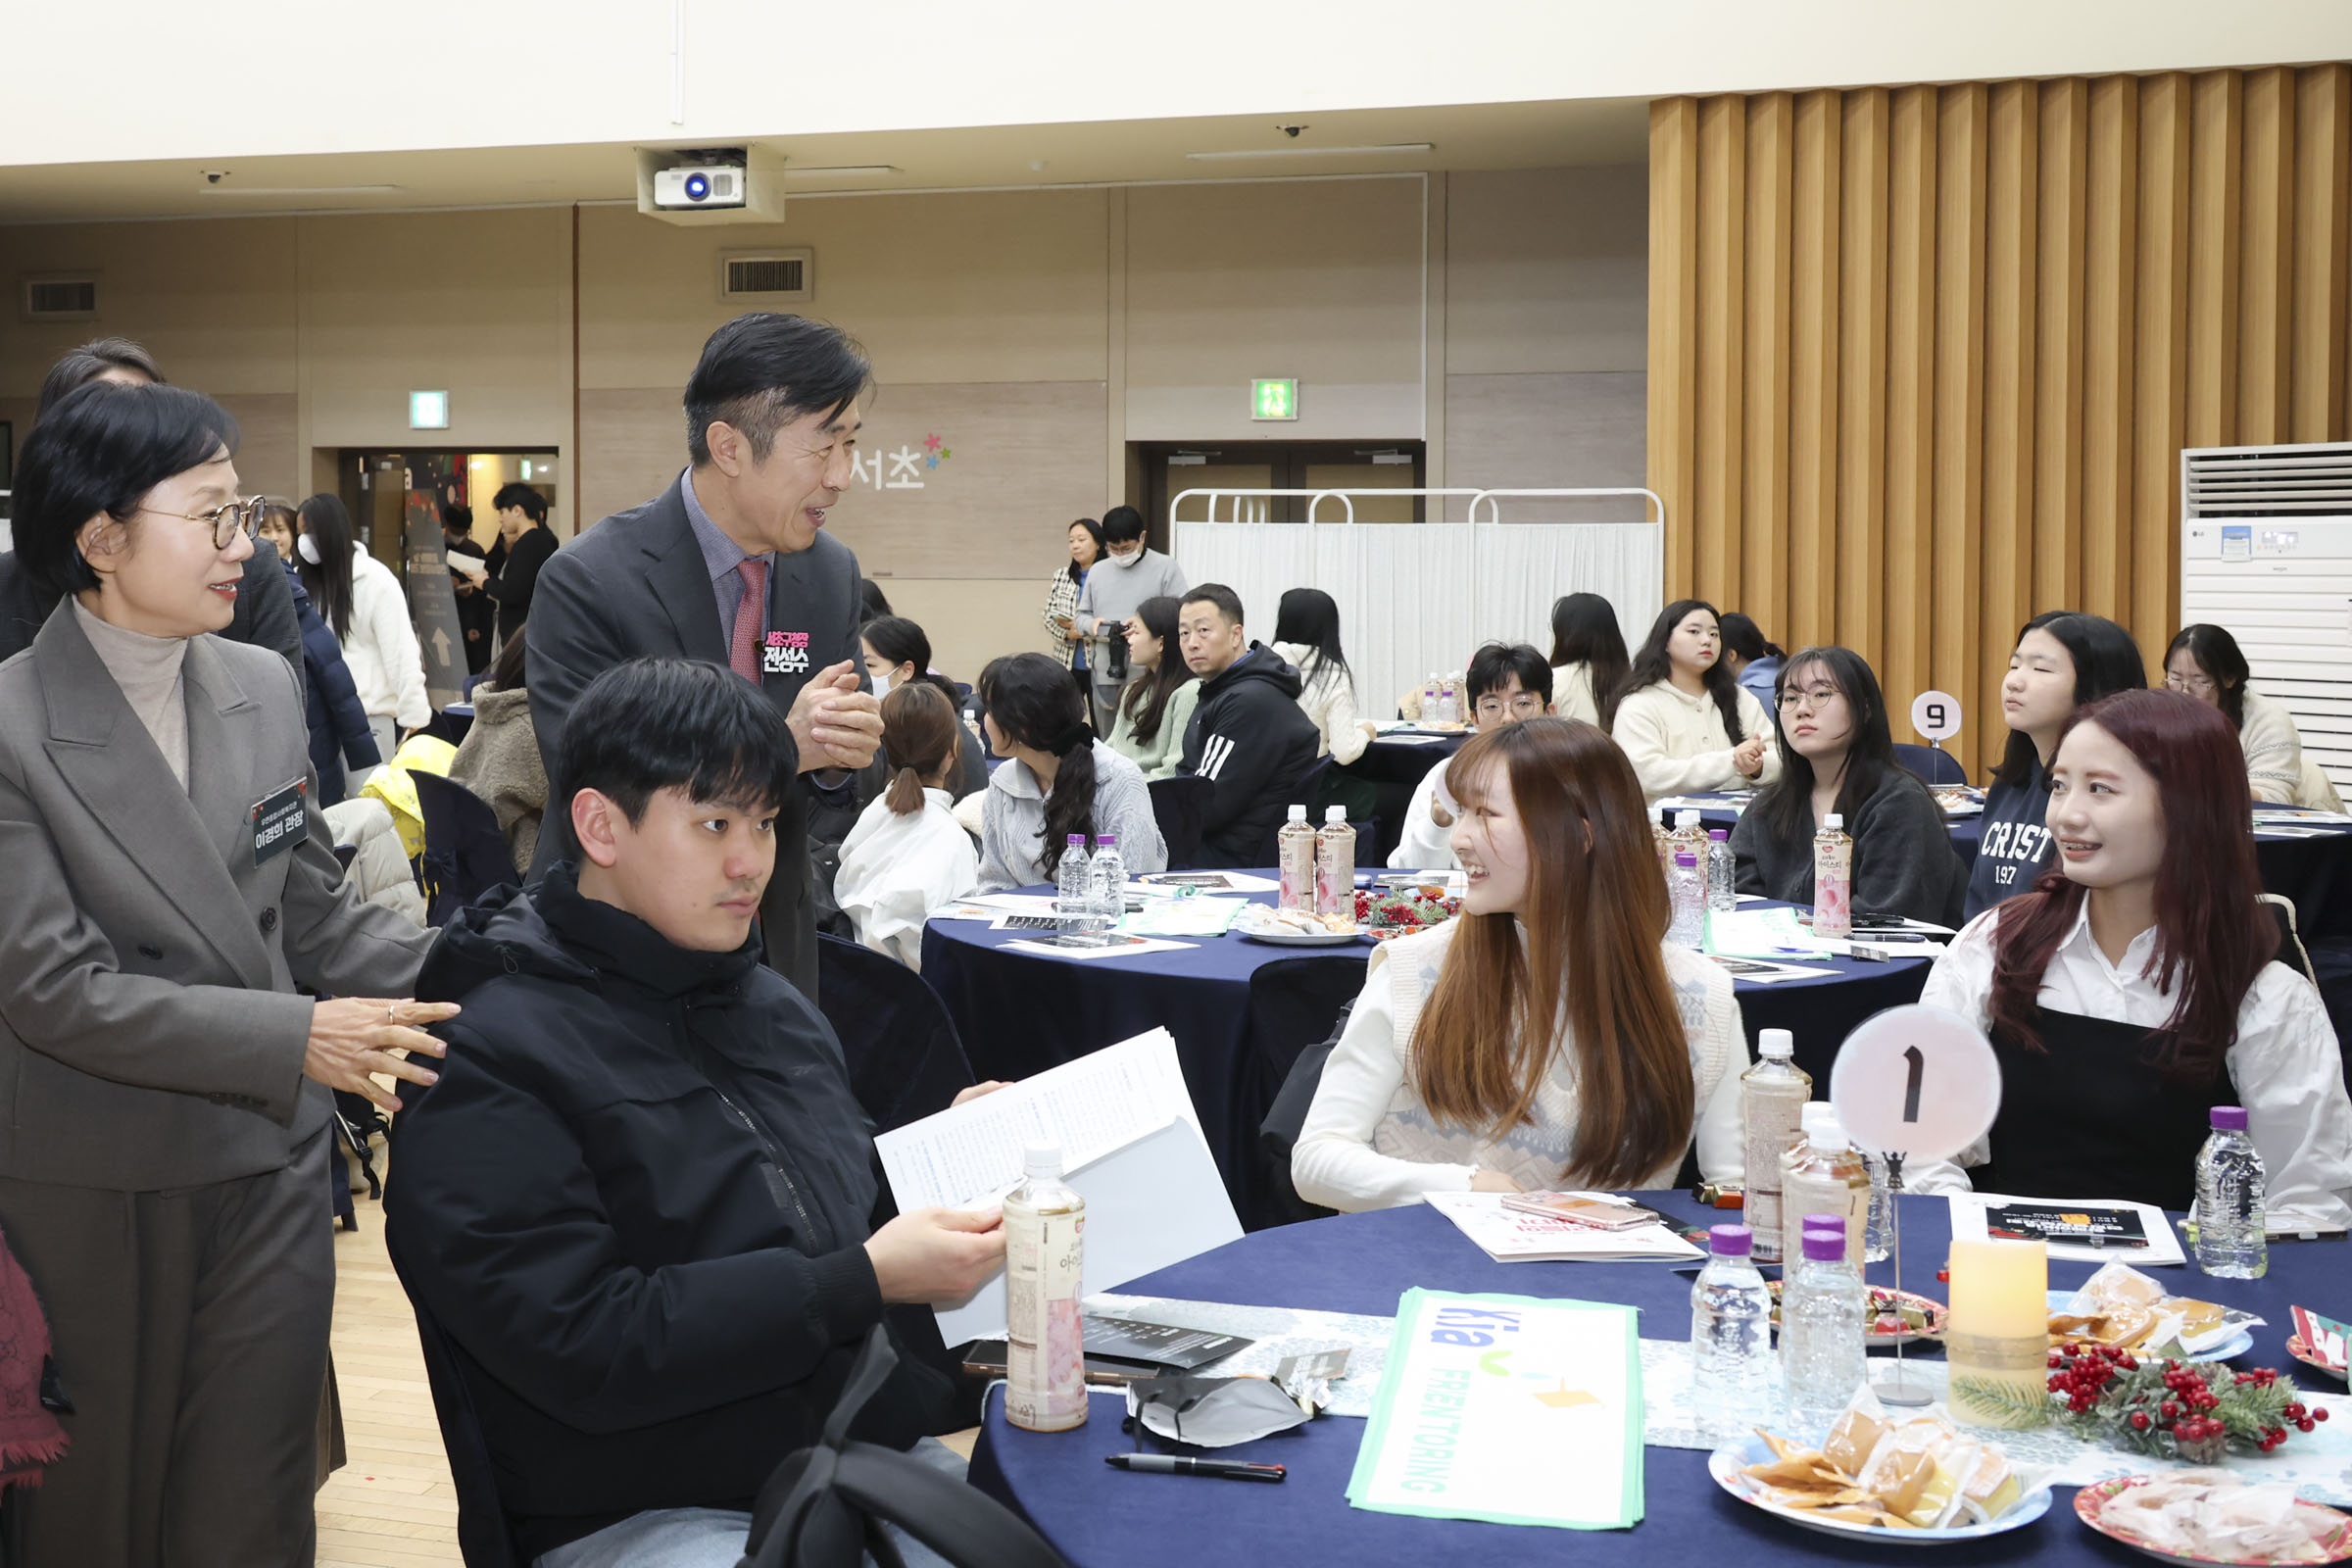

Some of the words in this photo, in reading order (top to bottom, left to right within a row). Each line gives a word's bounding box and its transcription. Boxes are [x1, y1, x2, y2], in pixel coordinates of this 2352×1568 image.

[849, 445, 925, 491] 서초
[763, 646, 809, 673] 전성수
[765, 630, 809, 648] 서초구청장
[1927, 704, 1945, 729] 9
[284, 809, 304, 833] 관장
[1982, 821, 2052, 863] CRIST
[1903, 1045, 1925, 1123] 1
[1430, 1307, 1522, 1348] Kia
[1399, 1367, 1472, 1493] FRIENTORING
